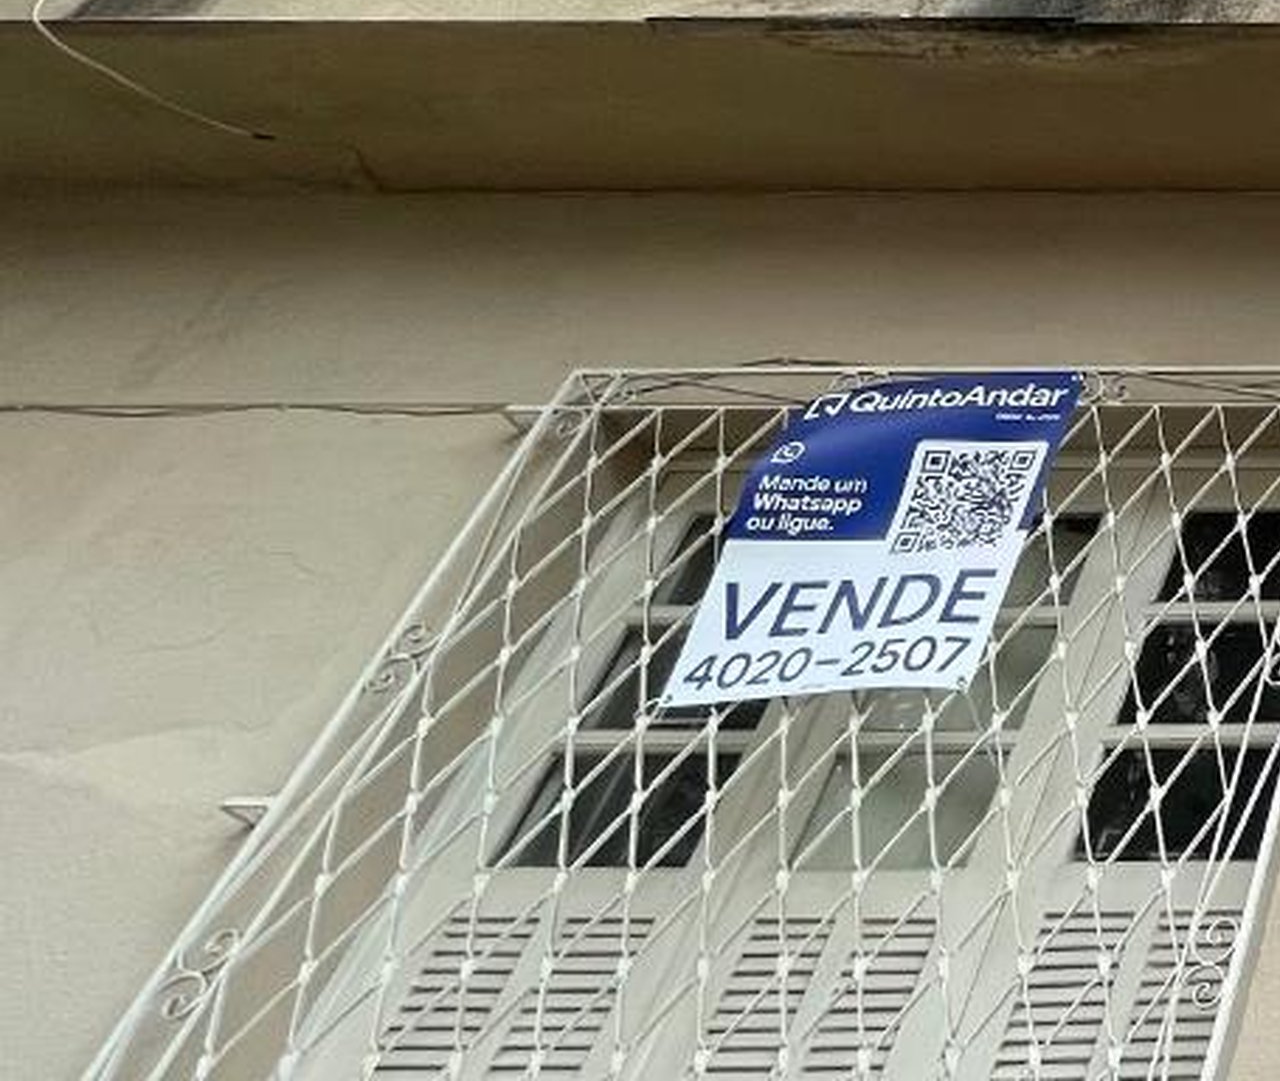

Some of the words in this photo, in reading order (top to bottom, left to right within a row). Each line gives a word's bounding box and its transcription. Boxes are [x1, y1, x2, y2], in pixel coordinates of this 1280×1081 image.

[850, 383, 1069, 414] QuintoAndar
[759, 474, 831, 491] Mande
[834, 477, 868, 493] um
[753, 492, 862, 516] Whatsapp
[746, 517, 775, 531] ou
[777, 513, 834, 536] ligue.
[724, 568, 998, 641] VENDE
[682, 634, 972, 691] 4020-2507
